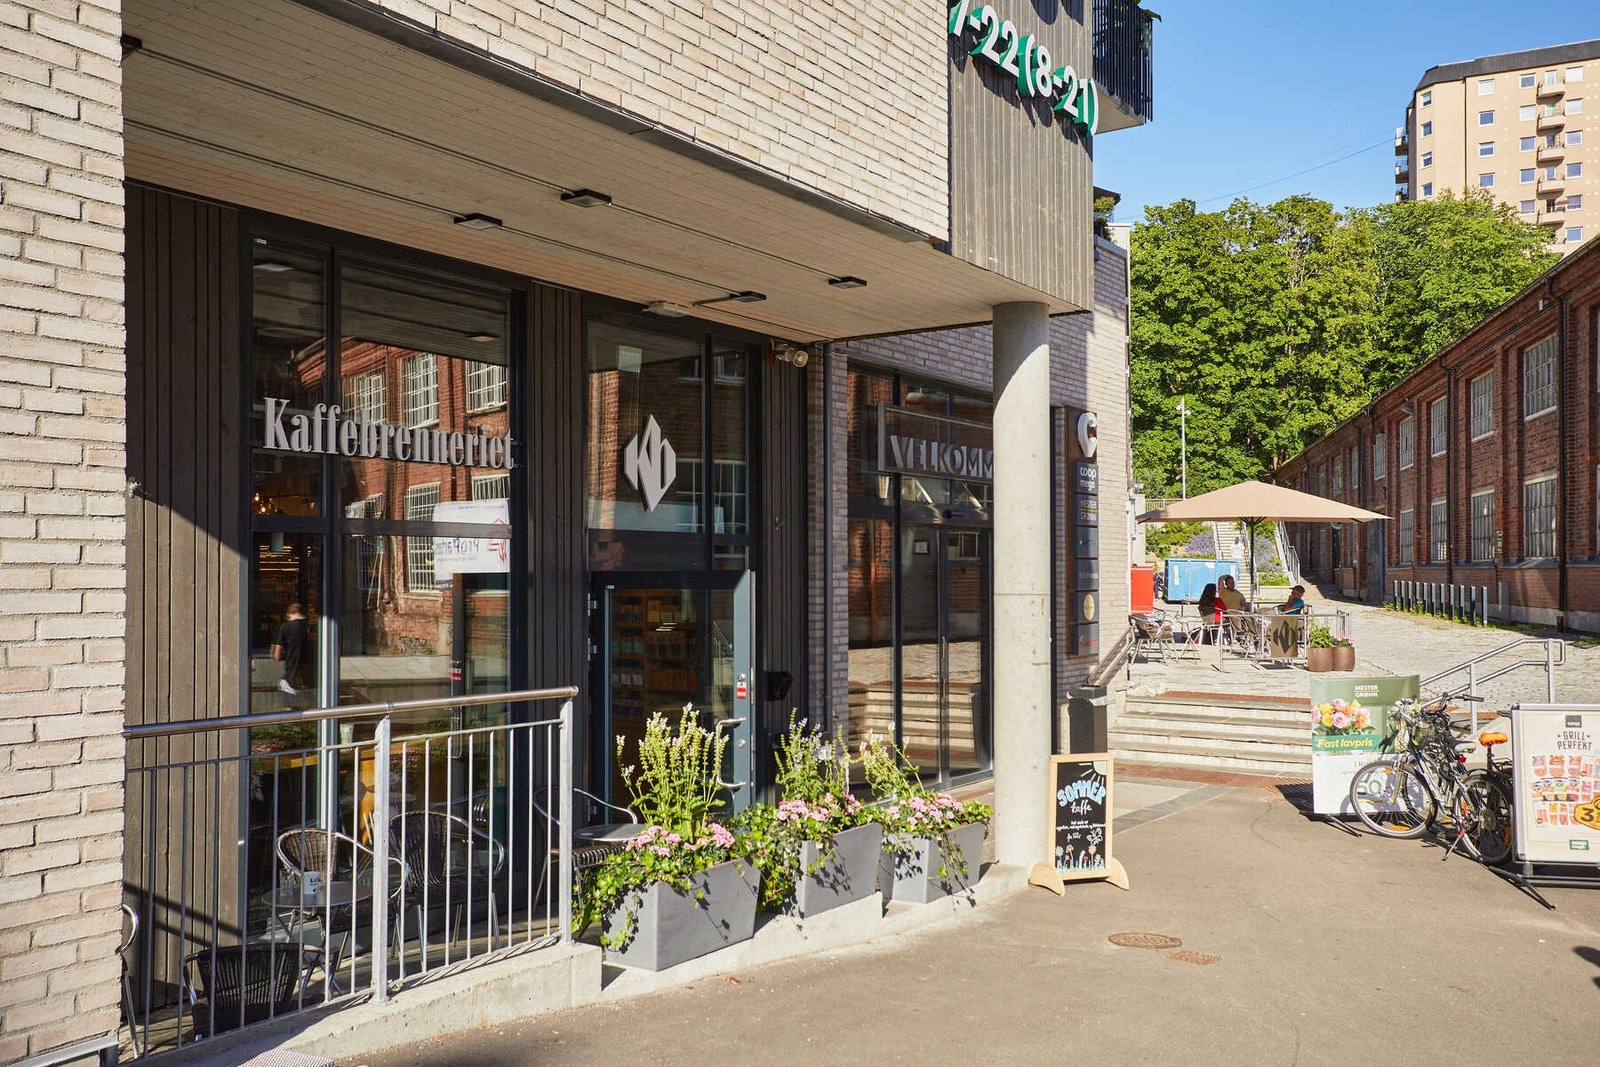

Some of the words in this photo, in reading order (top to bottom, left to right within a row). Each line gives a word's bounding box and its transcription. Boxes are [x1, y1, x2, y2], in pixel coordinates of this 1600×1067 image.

[262, 397, 515, 470] Kaffebrenneriet
[1079, 467, 1097, 480] coop
[1562, 730, 1586, 741] GRILL
[1317, 739, 1339, 748] Fast
[1341, 738, 1373, 749] lavpris
[1556, 740, 1593, 752] PERFEKT
[1057, 780, 1106, 807] SOMMER
